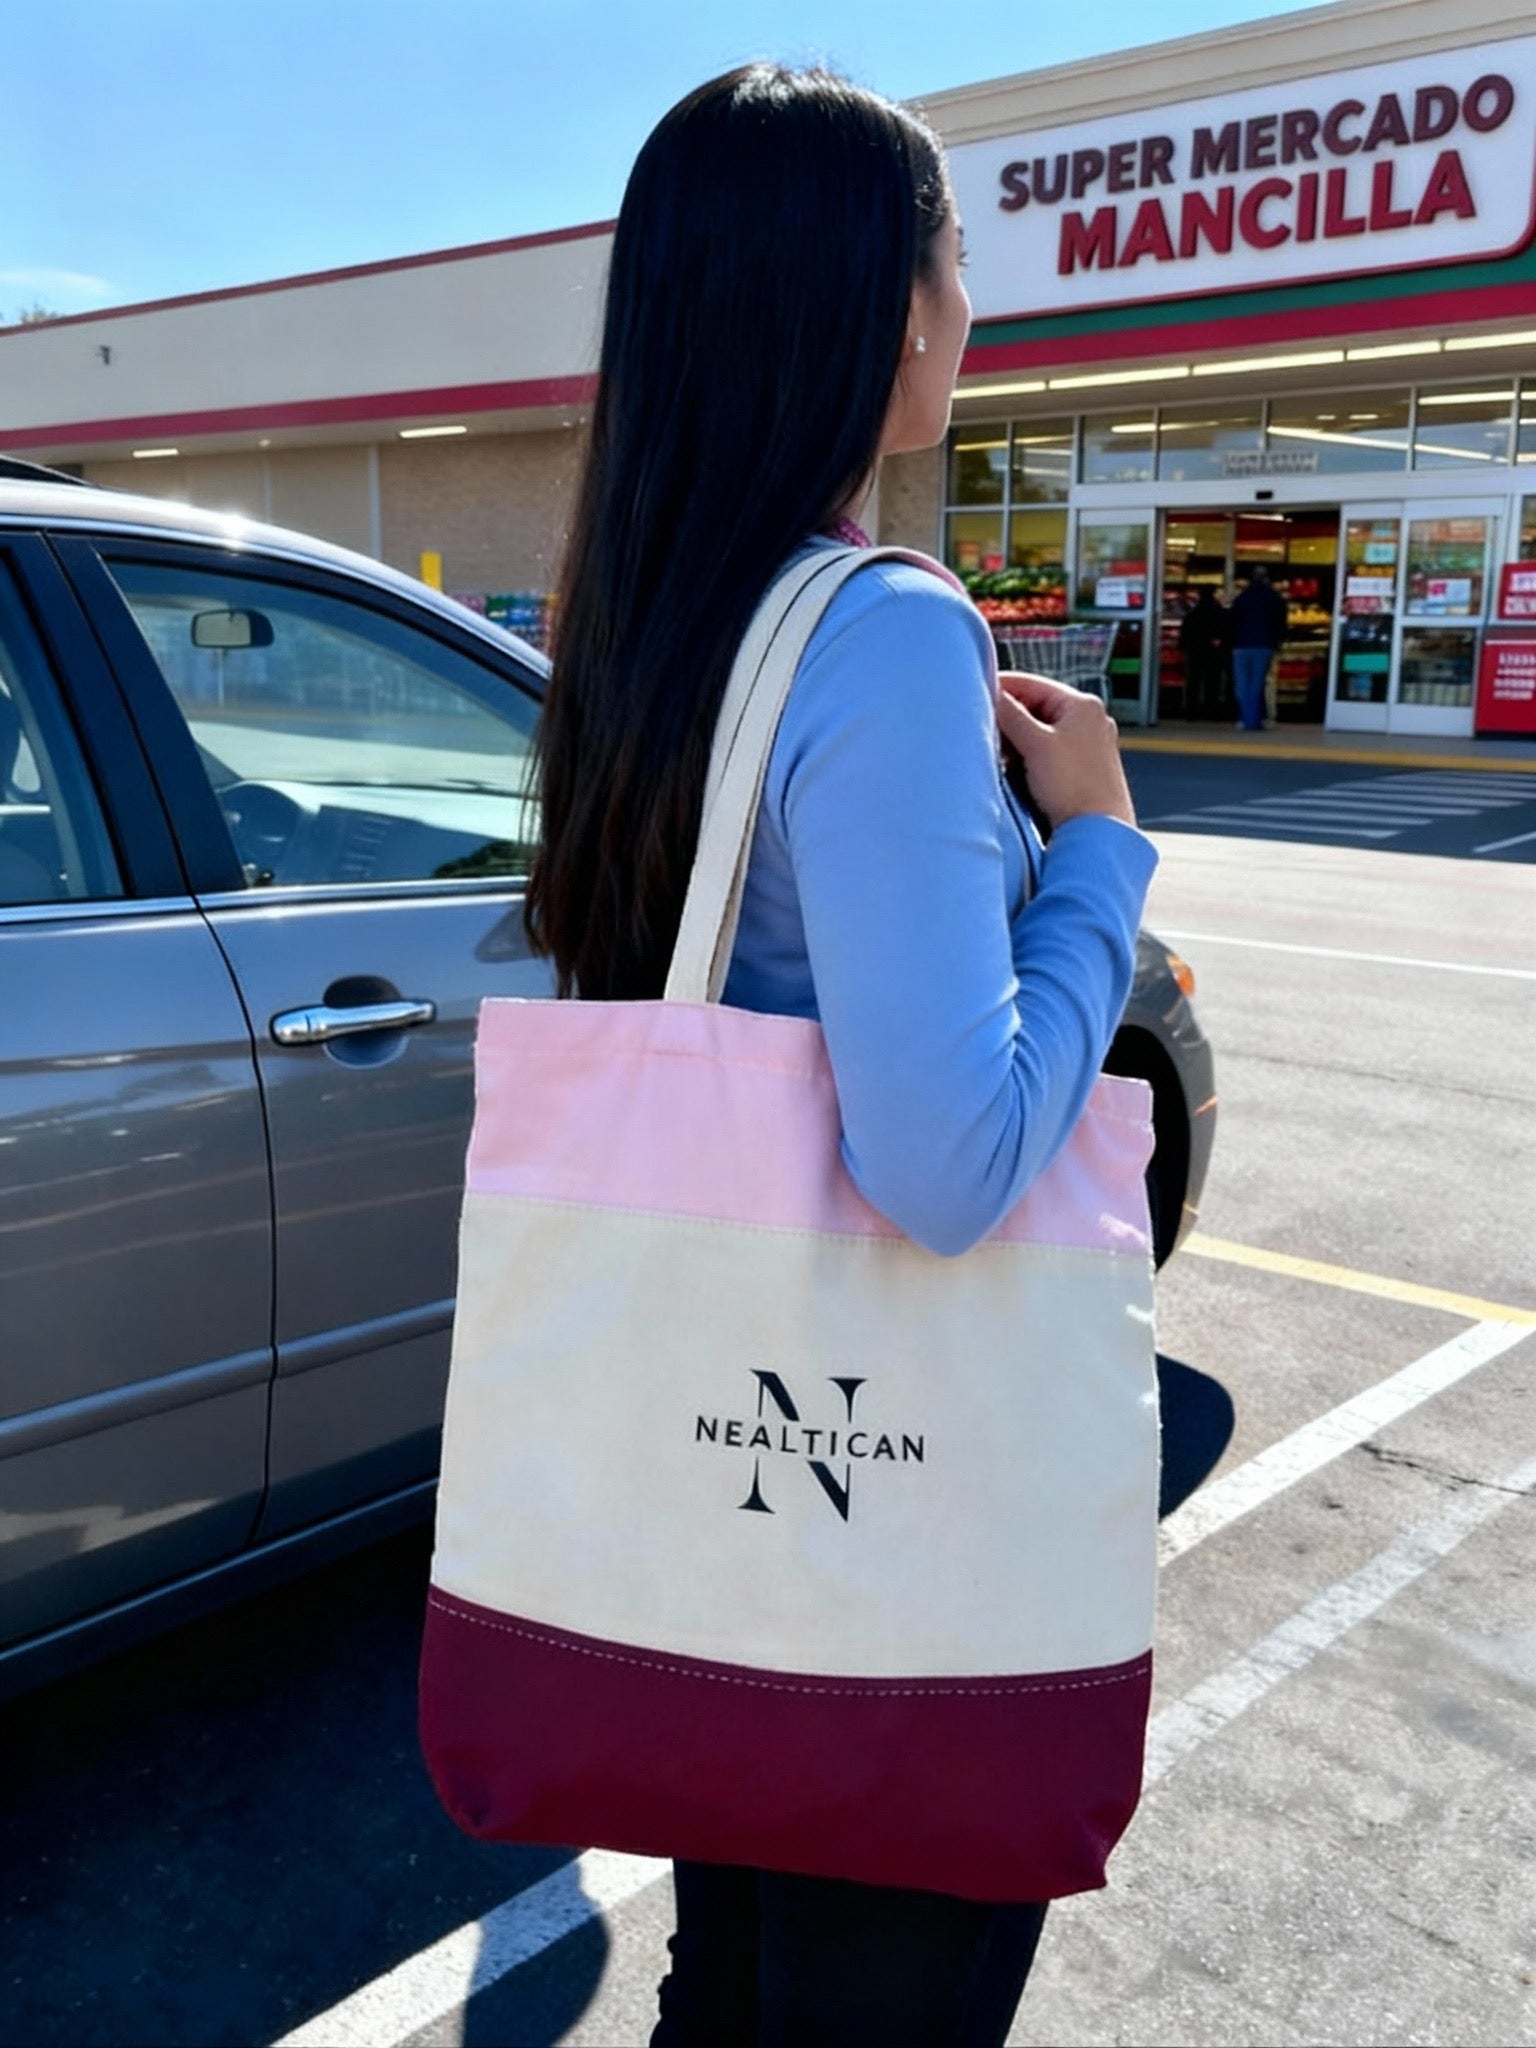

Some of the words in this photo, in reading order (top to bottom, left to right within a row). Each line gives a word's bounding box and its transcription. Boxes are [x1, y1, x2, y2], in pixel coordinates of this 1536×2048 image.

[999, 135, 1175, 212] SUPER
[1190, 74, 1515, 179] MERCADO
[1057, 150, 1476, 276] MANCILLA
[695, 1415, 924, 1462] NEALTICAN
